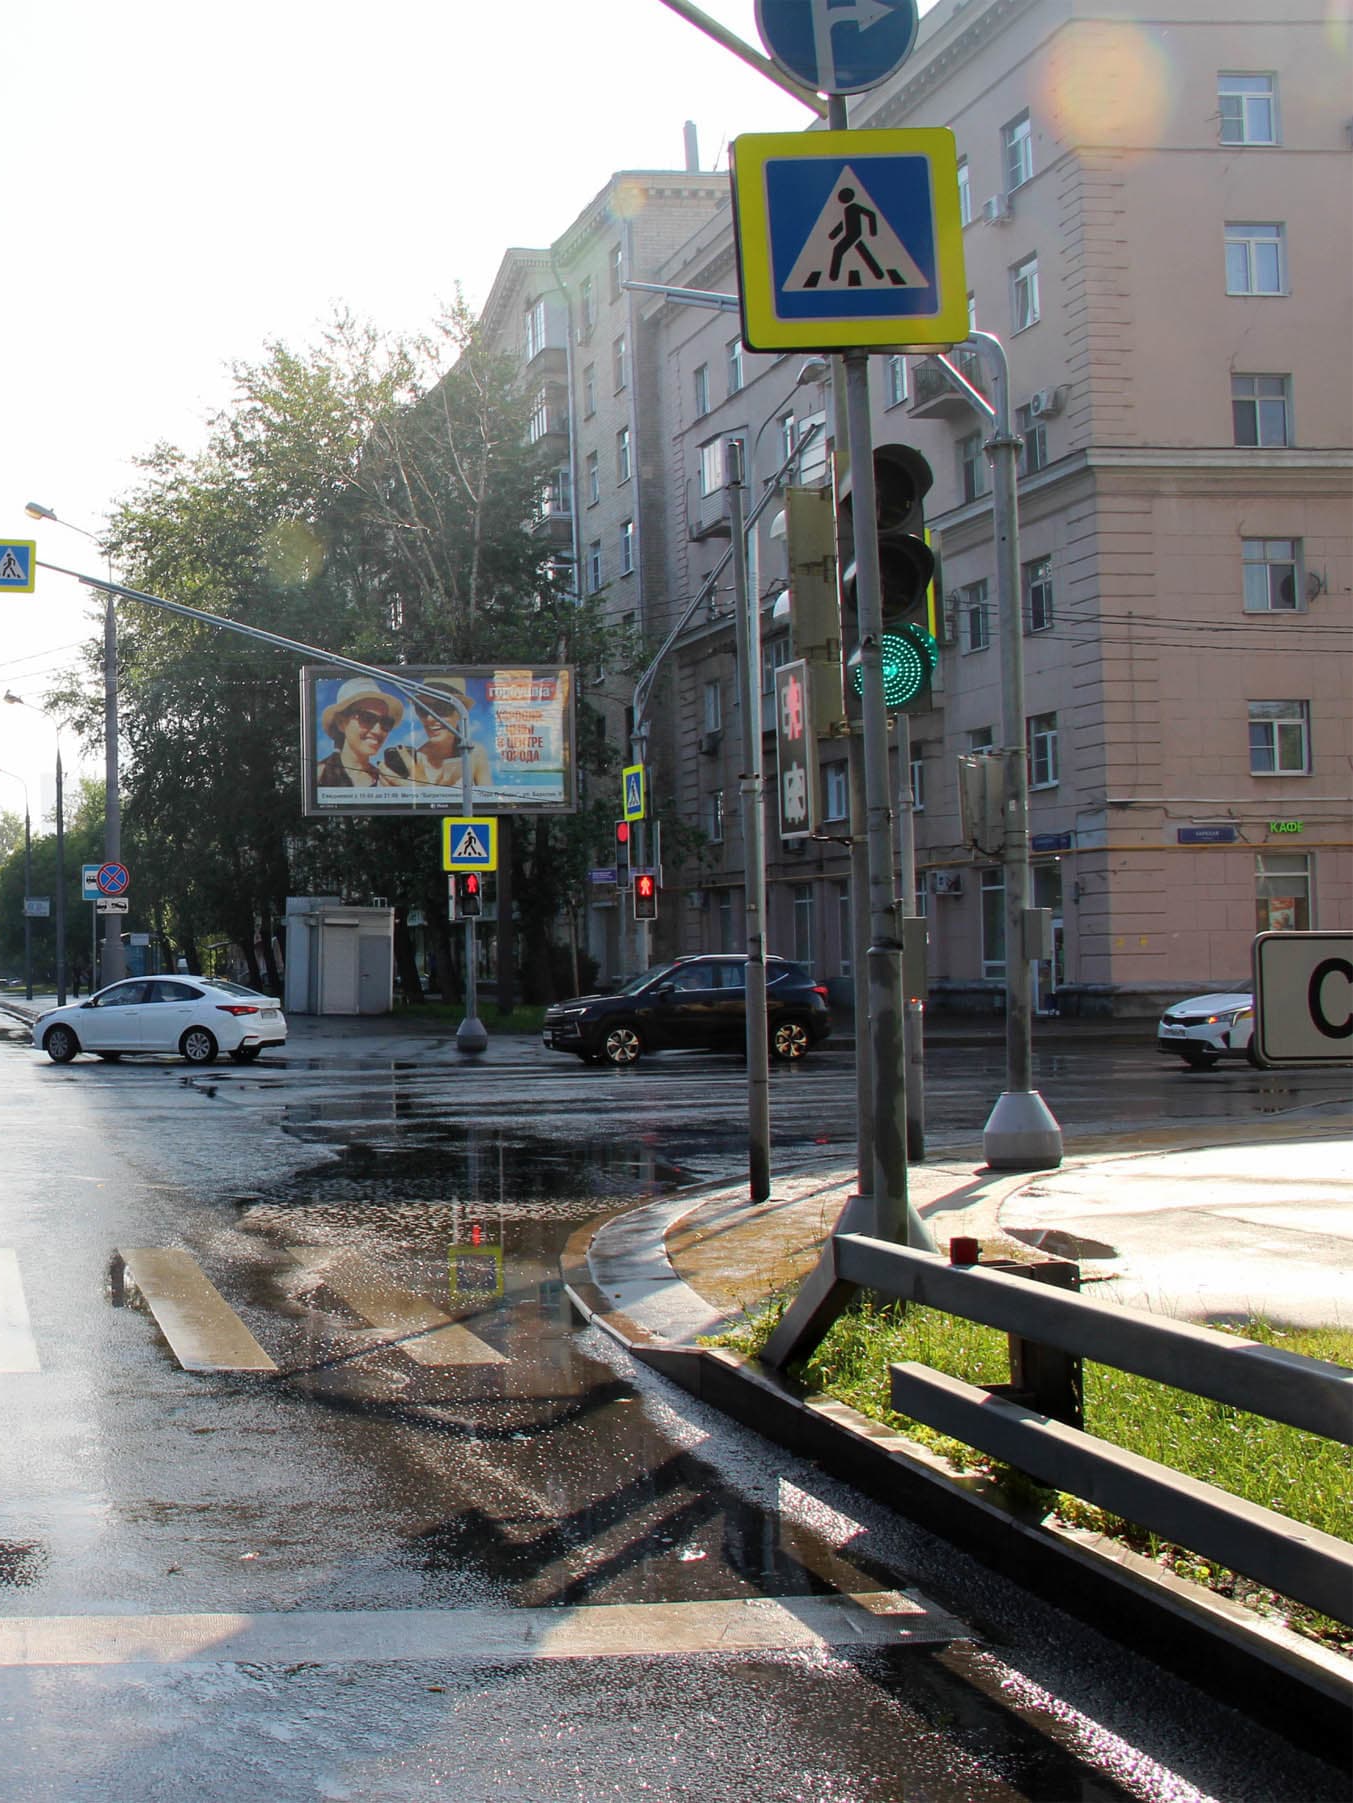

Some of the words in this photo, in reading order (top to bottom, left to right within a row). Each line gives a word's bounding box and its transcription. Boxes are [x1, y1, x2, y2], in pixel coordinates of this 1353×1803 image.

[506, 736, 544, 750] ЦЕНТРЕ
[501, 750, 541, 763] ГОРОДА
[1270, 822, 1304, 833] КАФЕ
